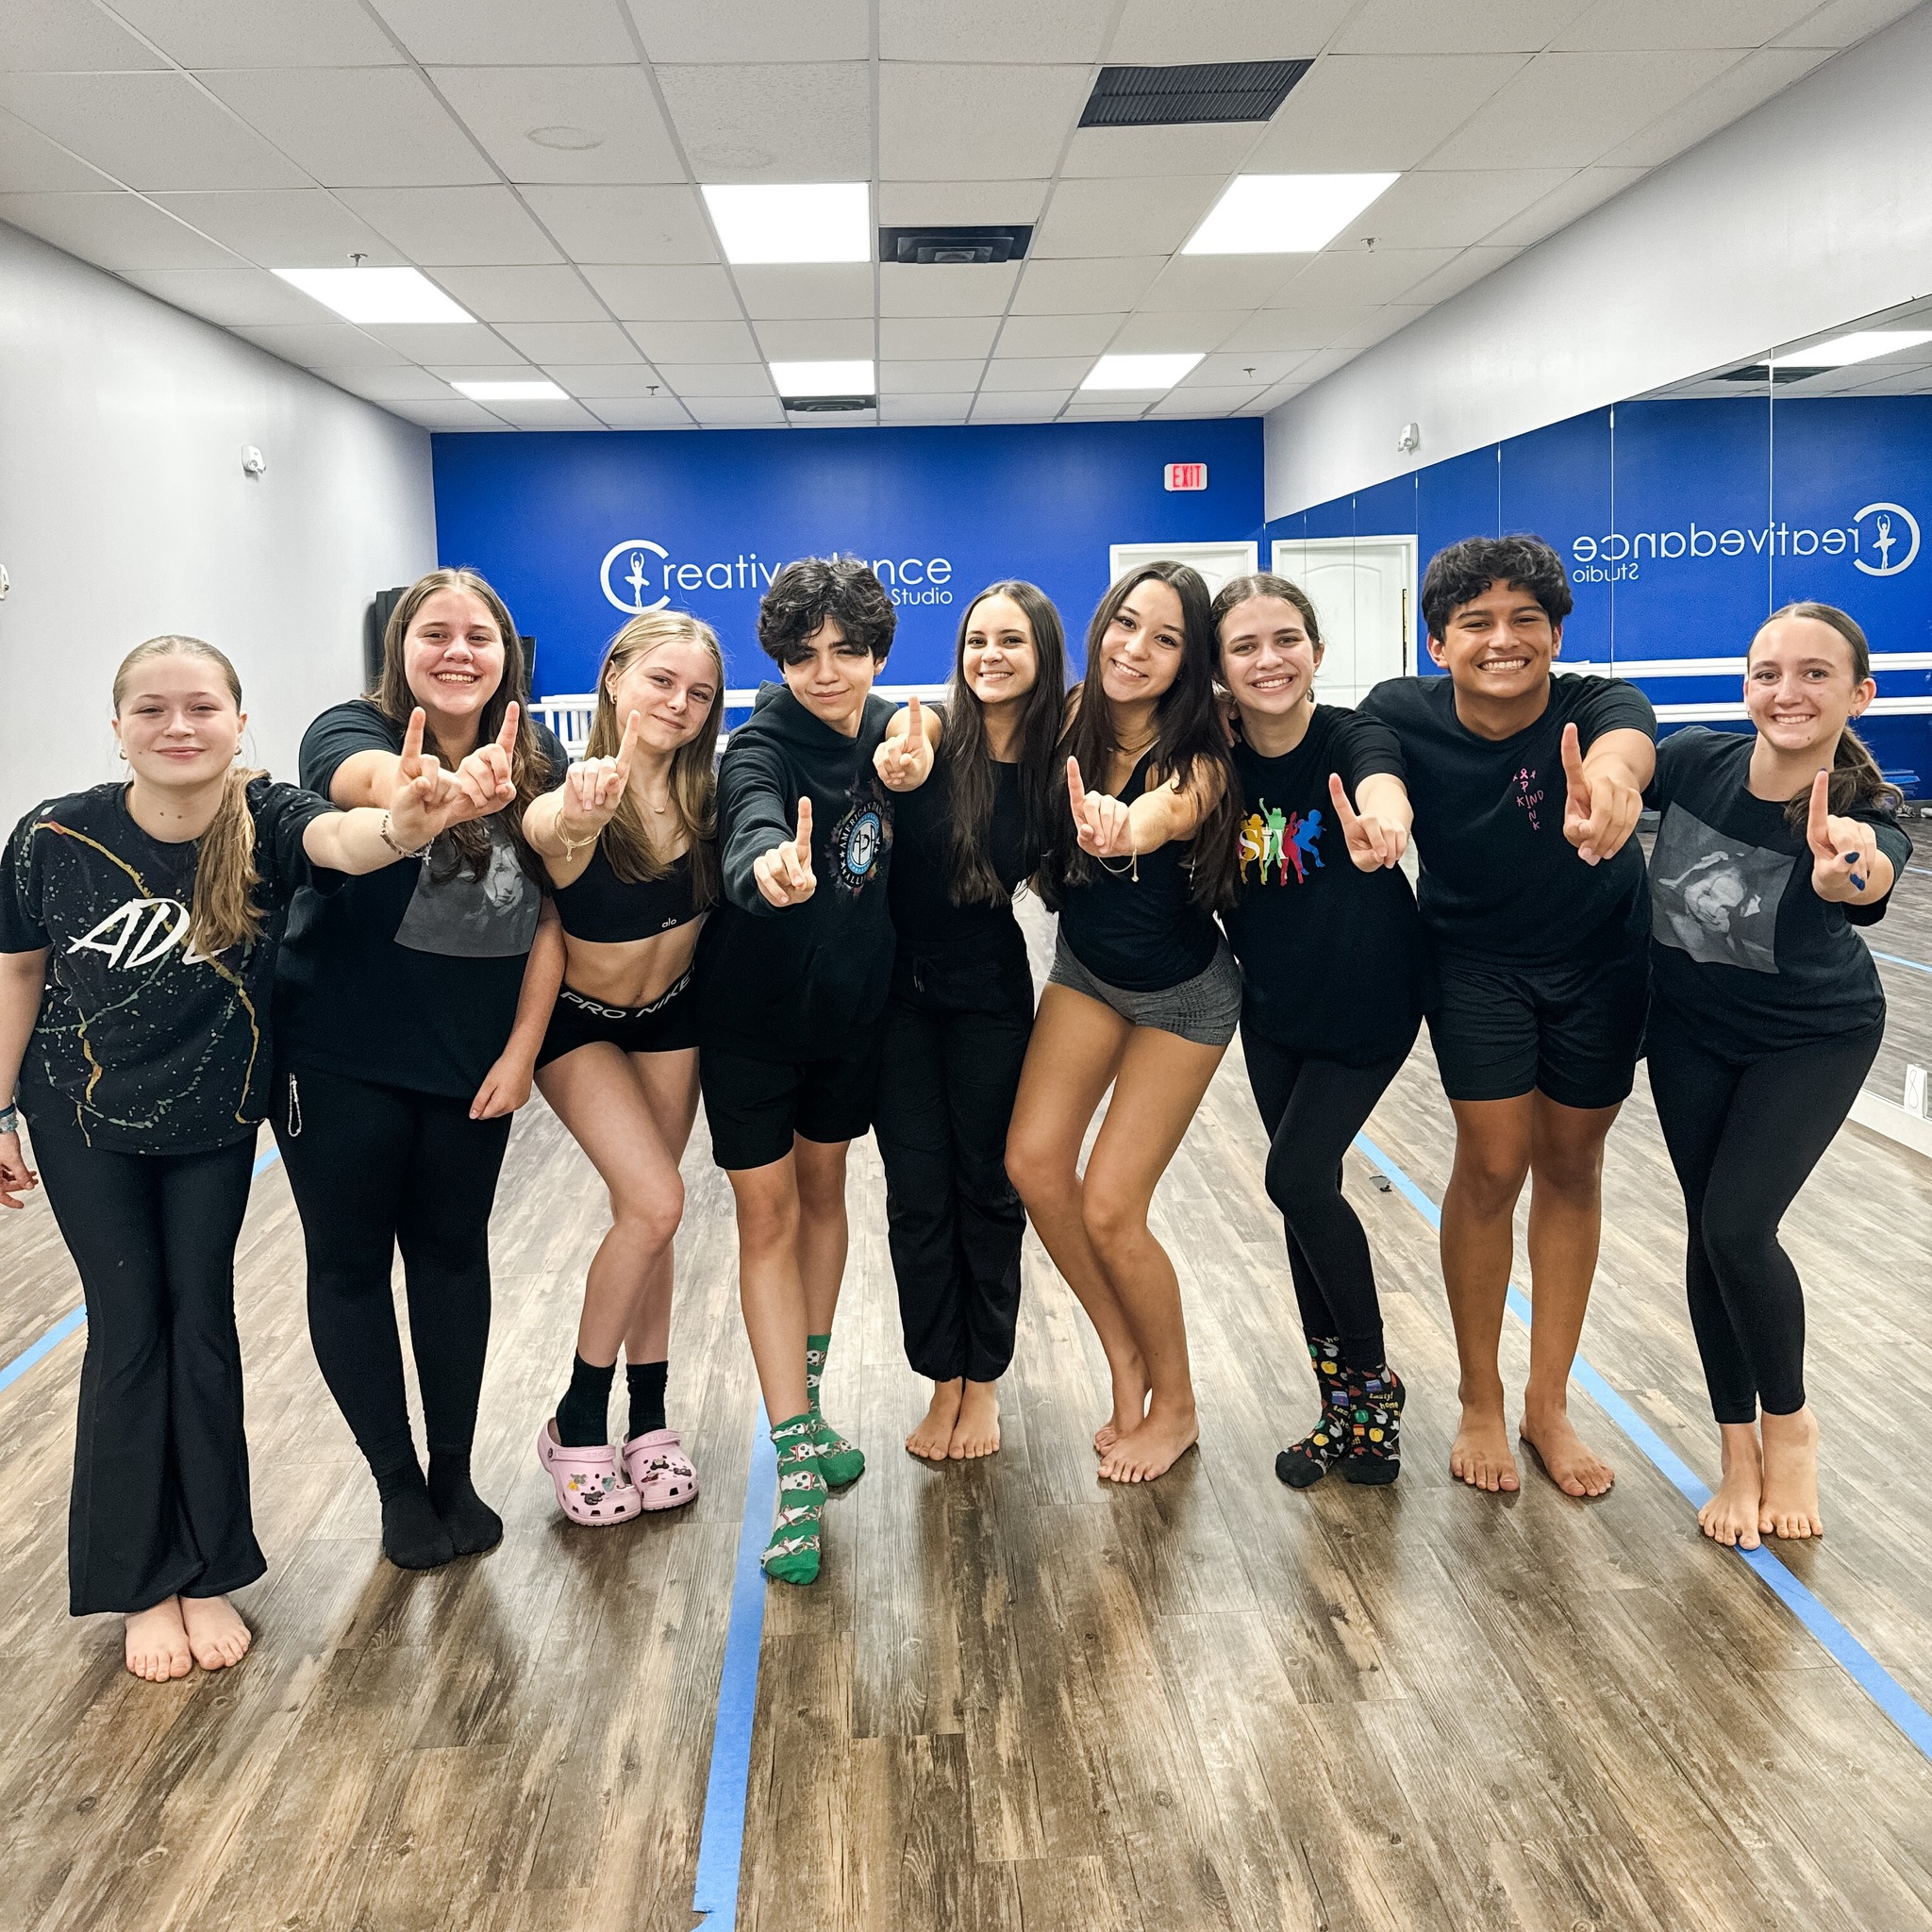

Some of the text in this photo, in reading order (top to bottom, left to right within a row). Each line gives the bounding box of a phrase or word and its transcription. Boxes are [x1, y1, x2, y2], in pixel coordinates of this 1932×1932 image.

[1173, 465, 1202, 488] EXIT
[891, 588, 953, 606] Studio
[661, 917, 677, 928] alo
[559, 969, 692, 1019] PRO NIKE
